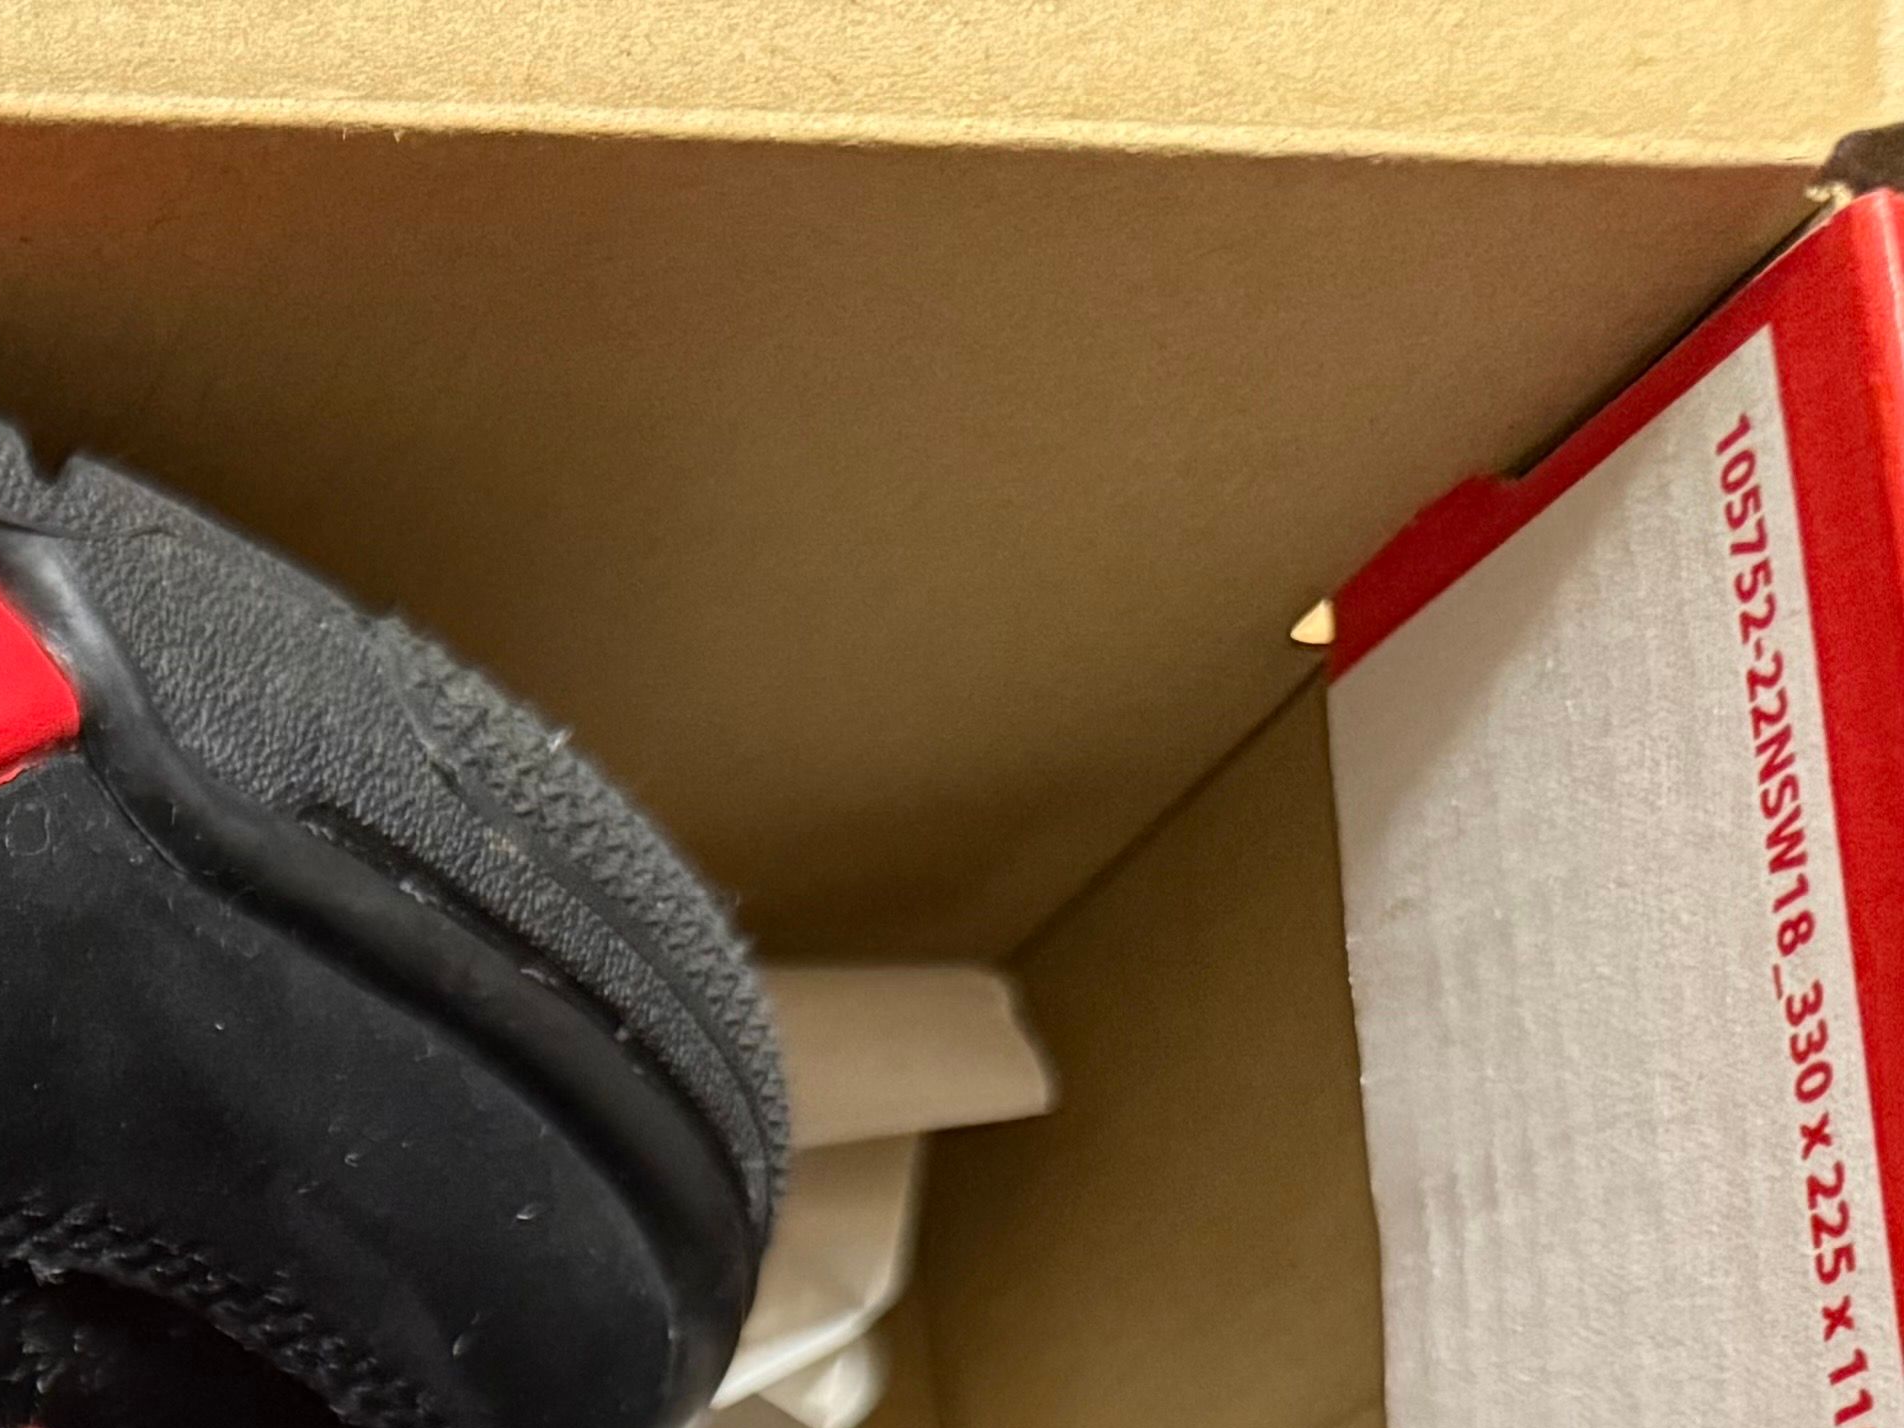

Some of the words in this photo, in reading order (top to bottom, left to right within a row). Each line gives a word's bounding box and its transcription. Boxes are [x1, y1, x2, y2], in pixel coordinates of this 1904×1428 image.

[1714, 414, 1836, 1106] 105752-22NSW18_330
[1798, 1112, 1836, 1160] x
[1805, 1160, 1858, 1287] 225
[1820, 1296, 1857, 1343] x
